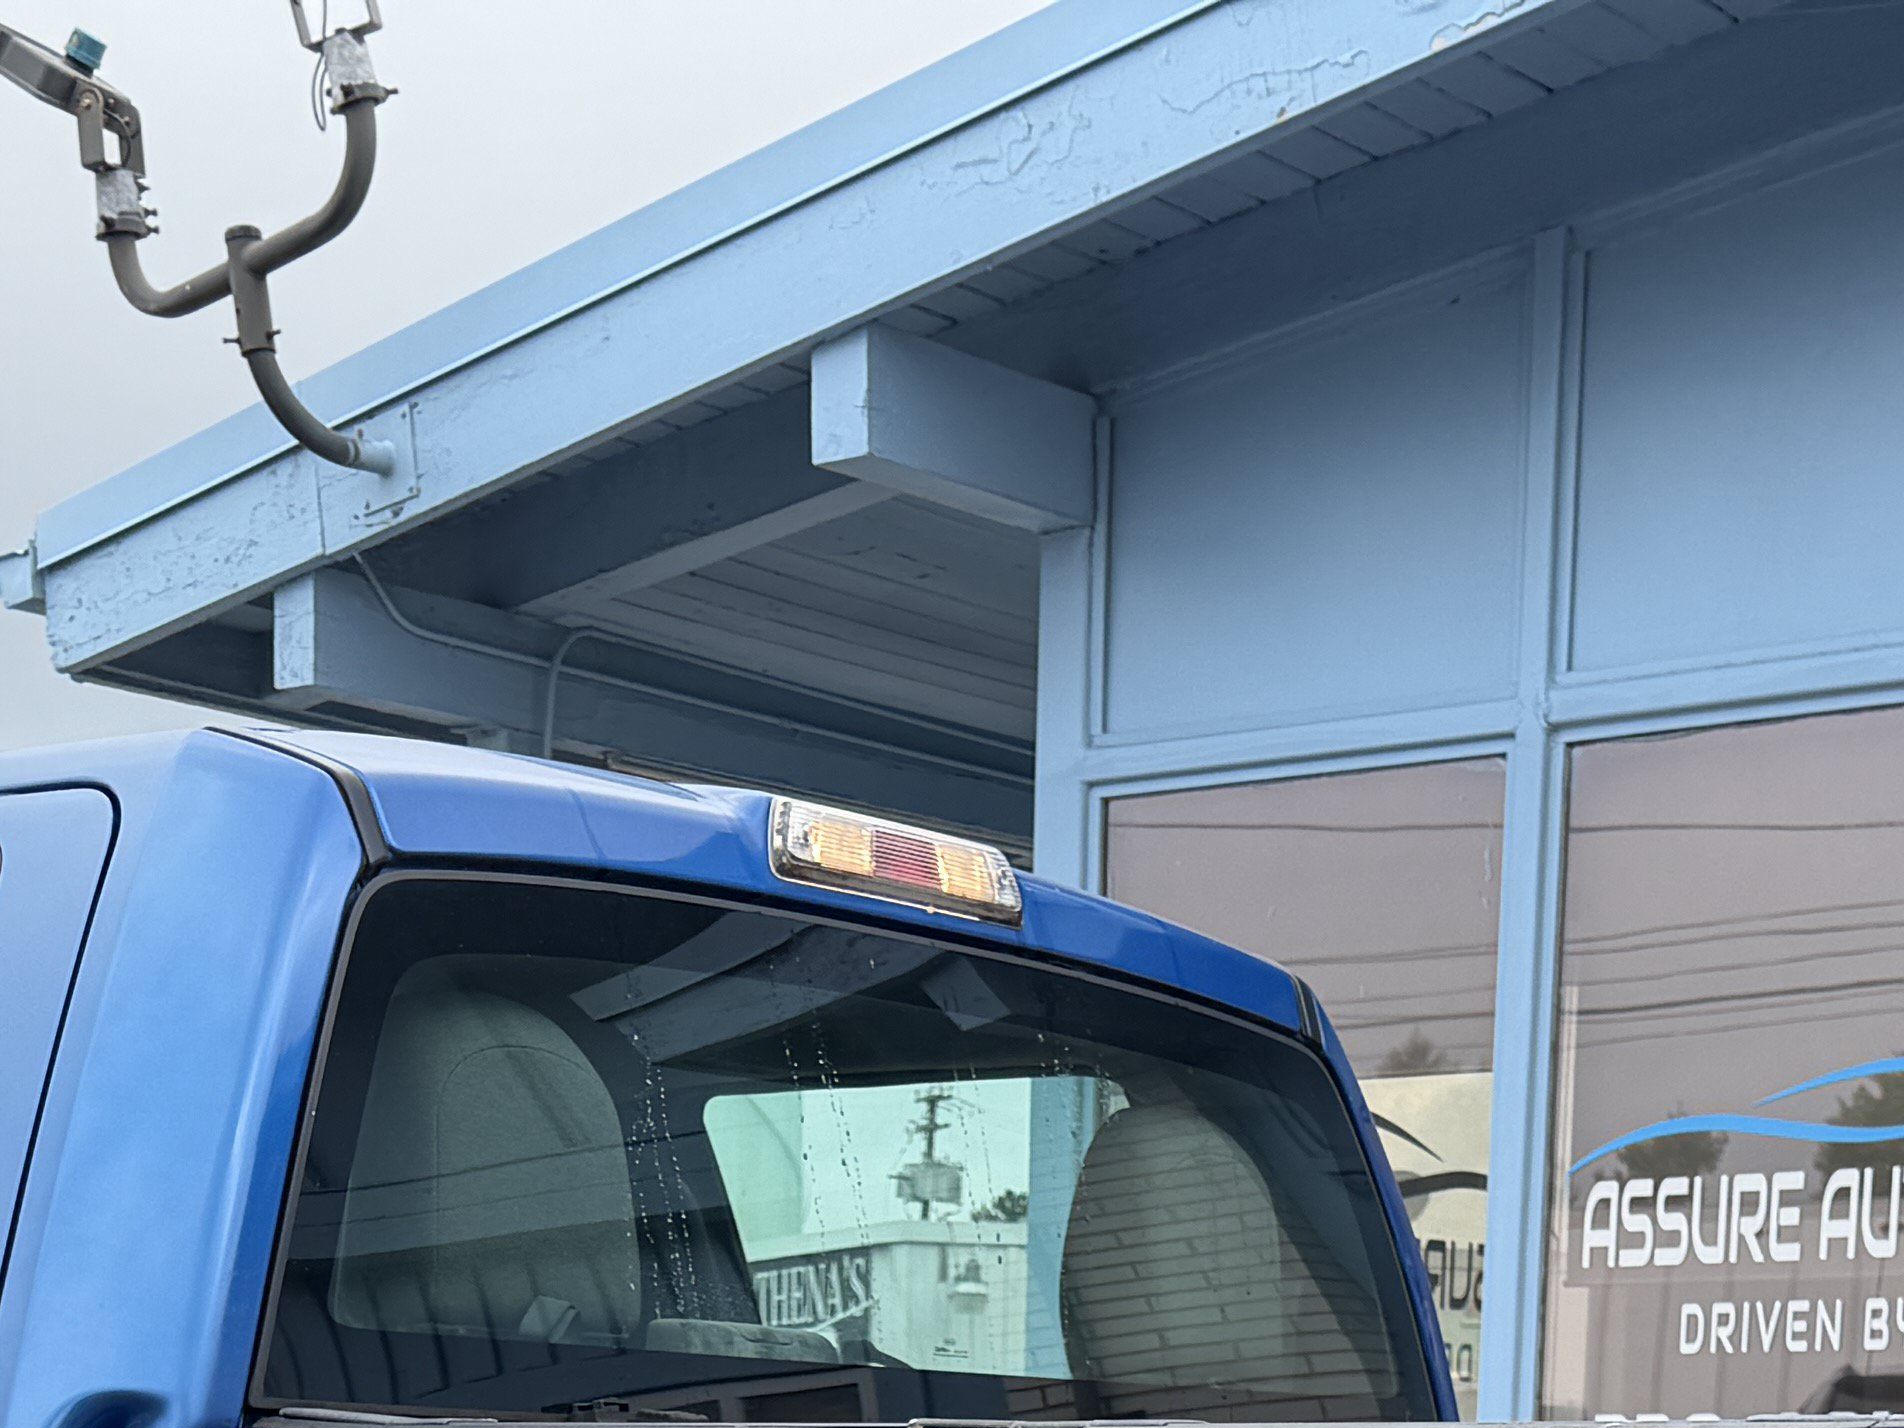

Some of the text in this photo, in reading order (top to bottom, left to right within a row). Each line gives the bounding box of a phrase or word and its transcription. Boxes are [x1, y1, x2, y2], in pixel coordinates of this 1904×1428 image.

[1581, 1170, 1805, 1269] ASSURE
[753, 1255, 867, 1327] THENA'S
[1679, 1299, 1843, 1355] DRIVEN
